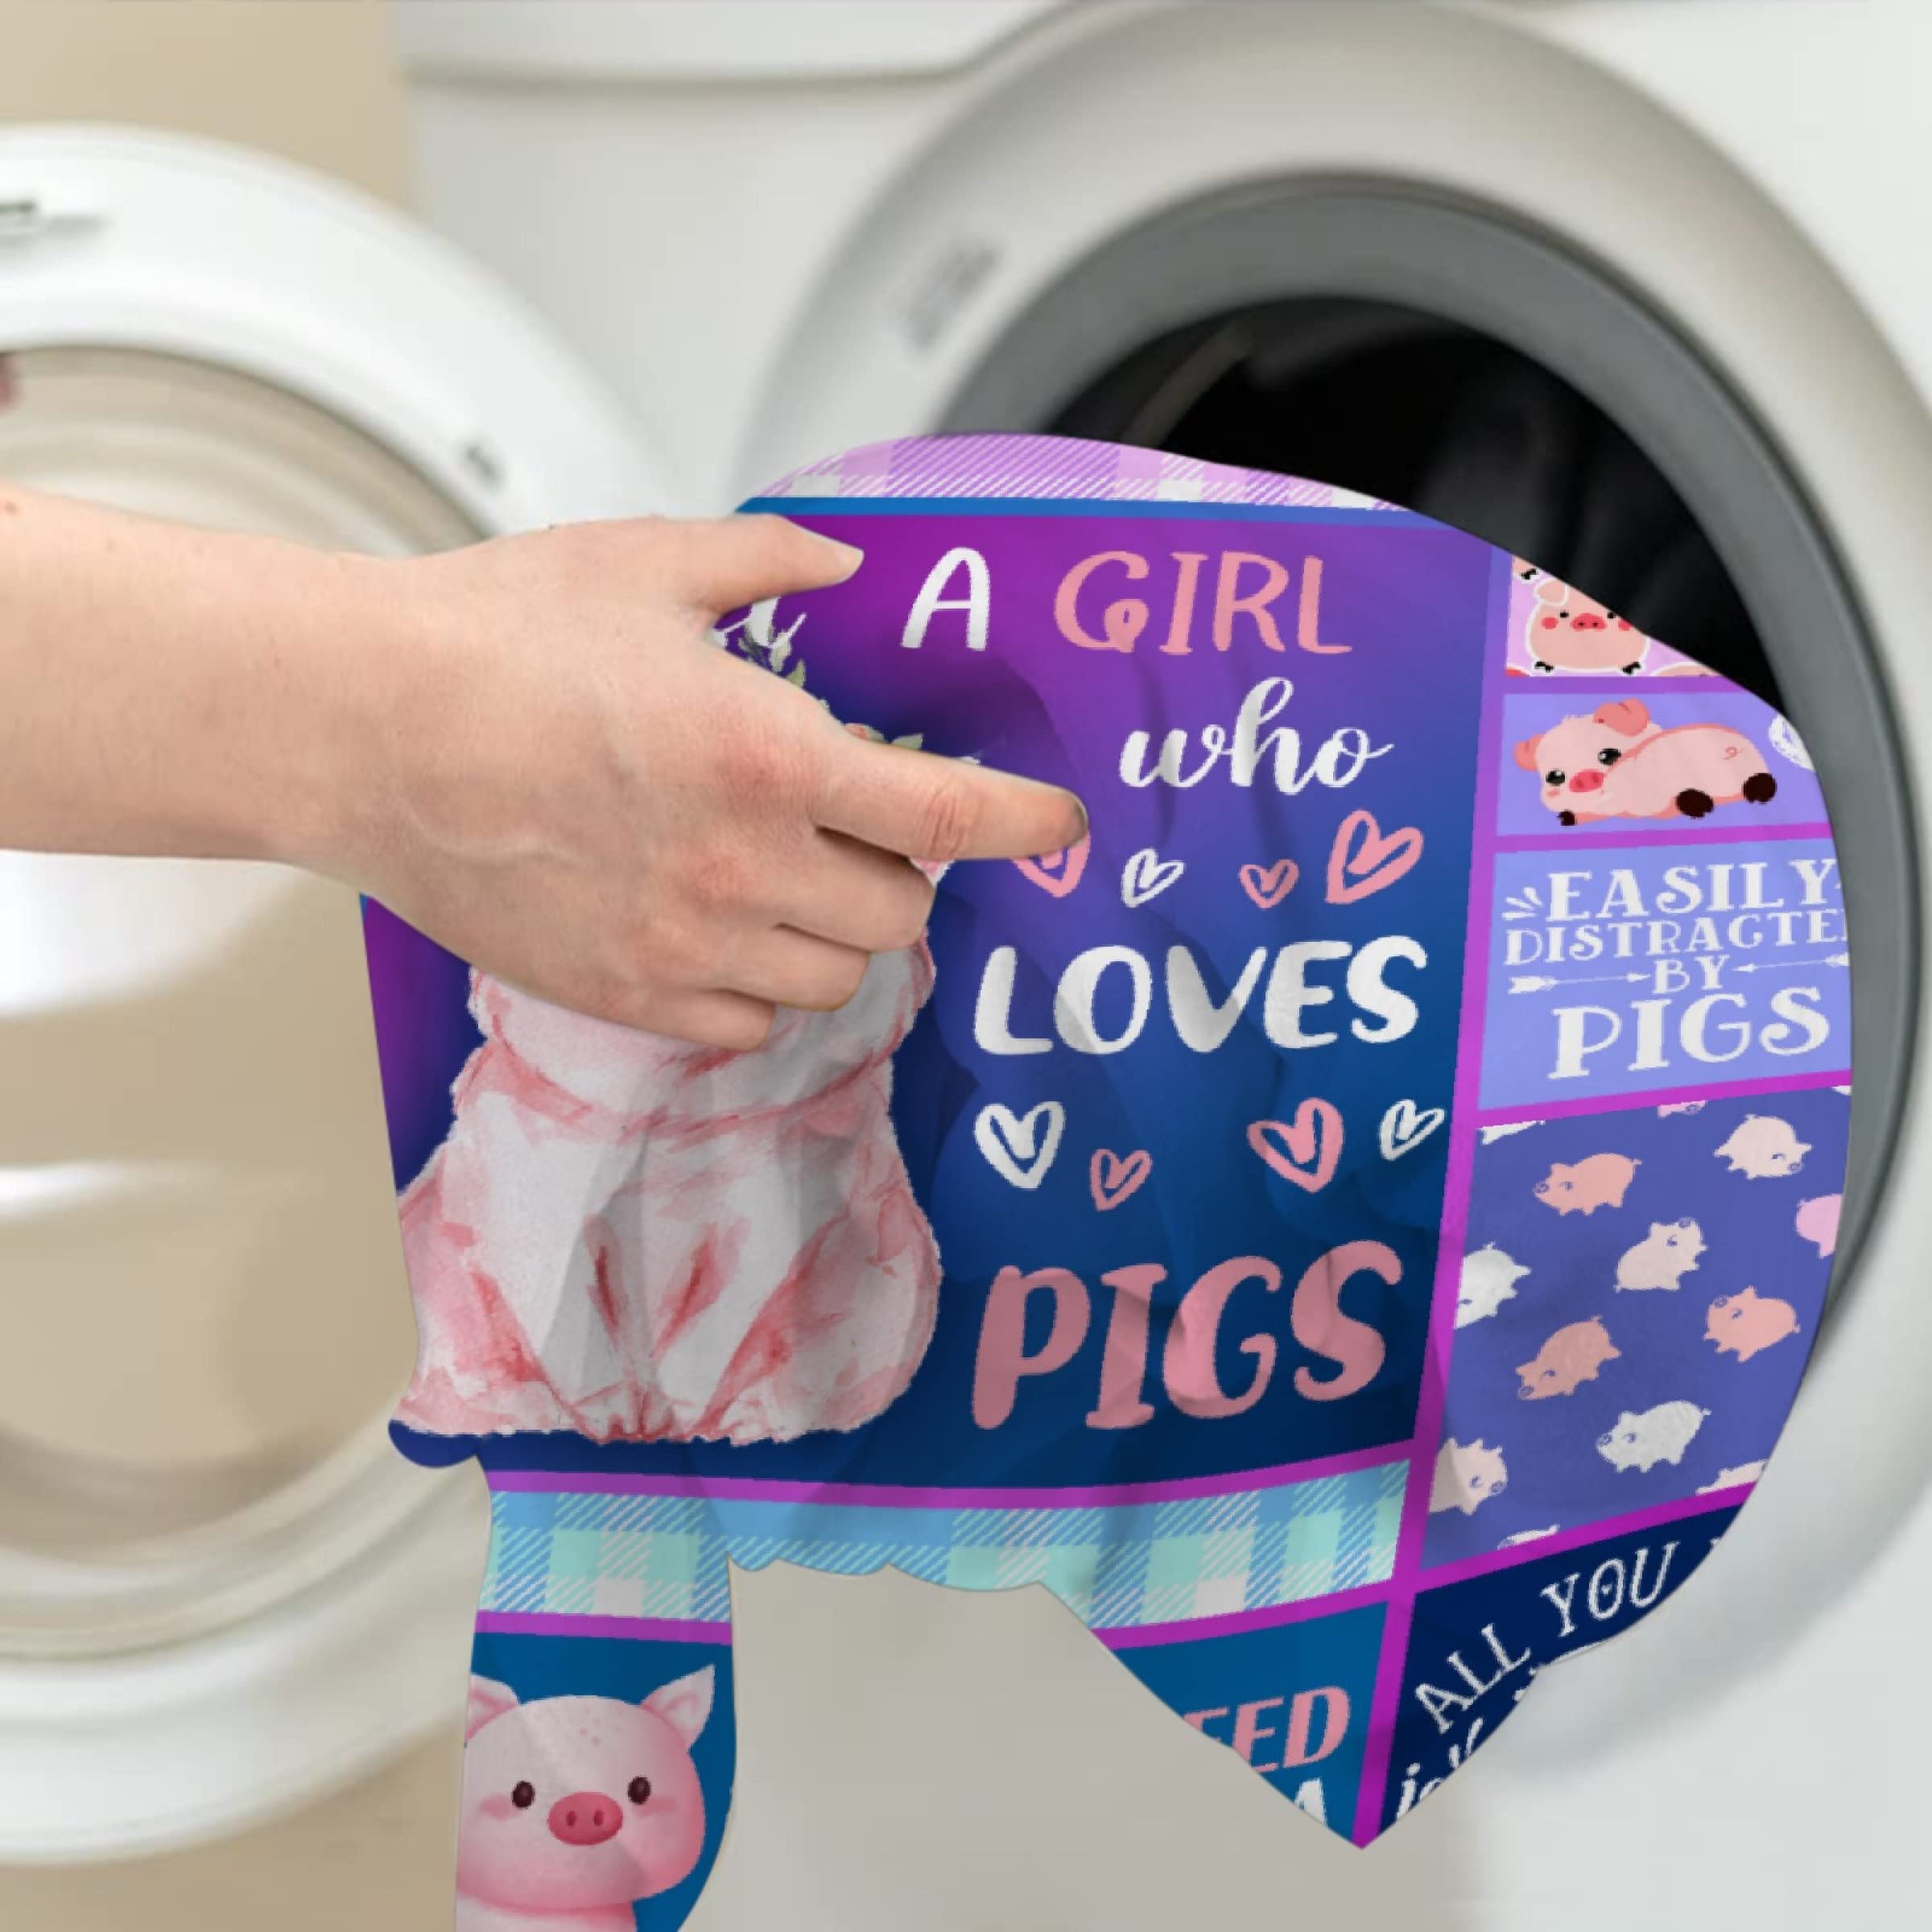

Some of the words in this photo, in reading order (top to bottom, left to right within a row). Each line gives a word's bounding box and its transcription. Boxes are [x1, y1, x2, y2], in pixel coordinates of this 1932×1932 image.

[901, 547, 991, 650] A
[1053, 550, 1352, 655] GIRL
[1119, 676, 1394, 795] who
[1503, 907, 1848, 966] DISTRACTE
[1545, 858, 1838, 922] EASILY
[973, 935, 1428, 1055] LOVES
[1652, 954, 1730, 995] BY
[1547, 986, 1830, 1080] PIGS
[971, 1240, 1404, 1430] PIGS
[1414, 1622, 1532, 1734] ALL
[1540, 1540, 1681, 1638] YOU
